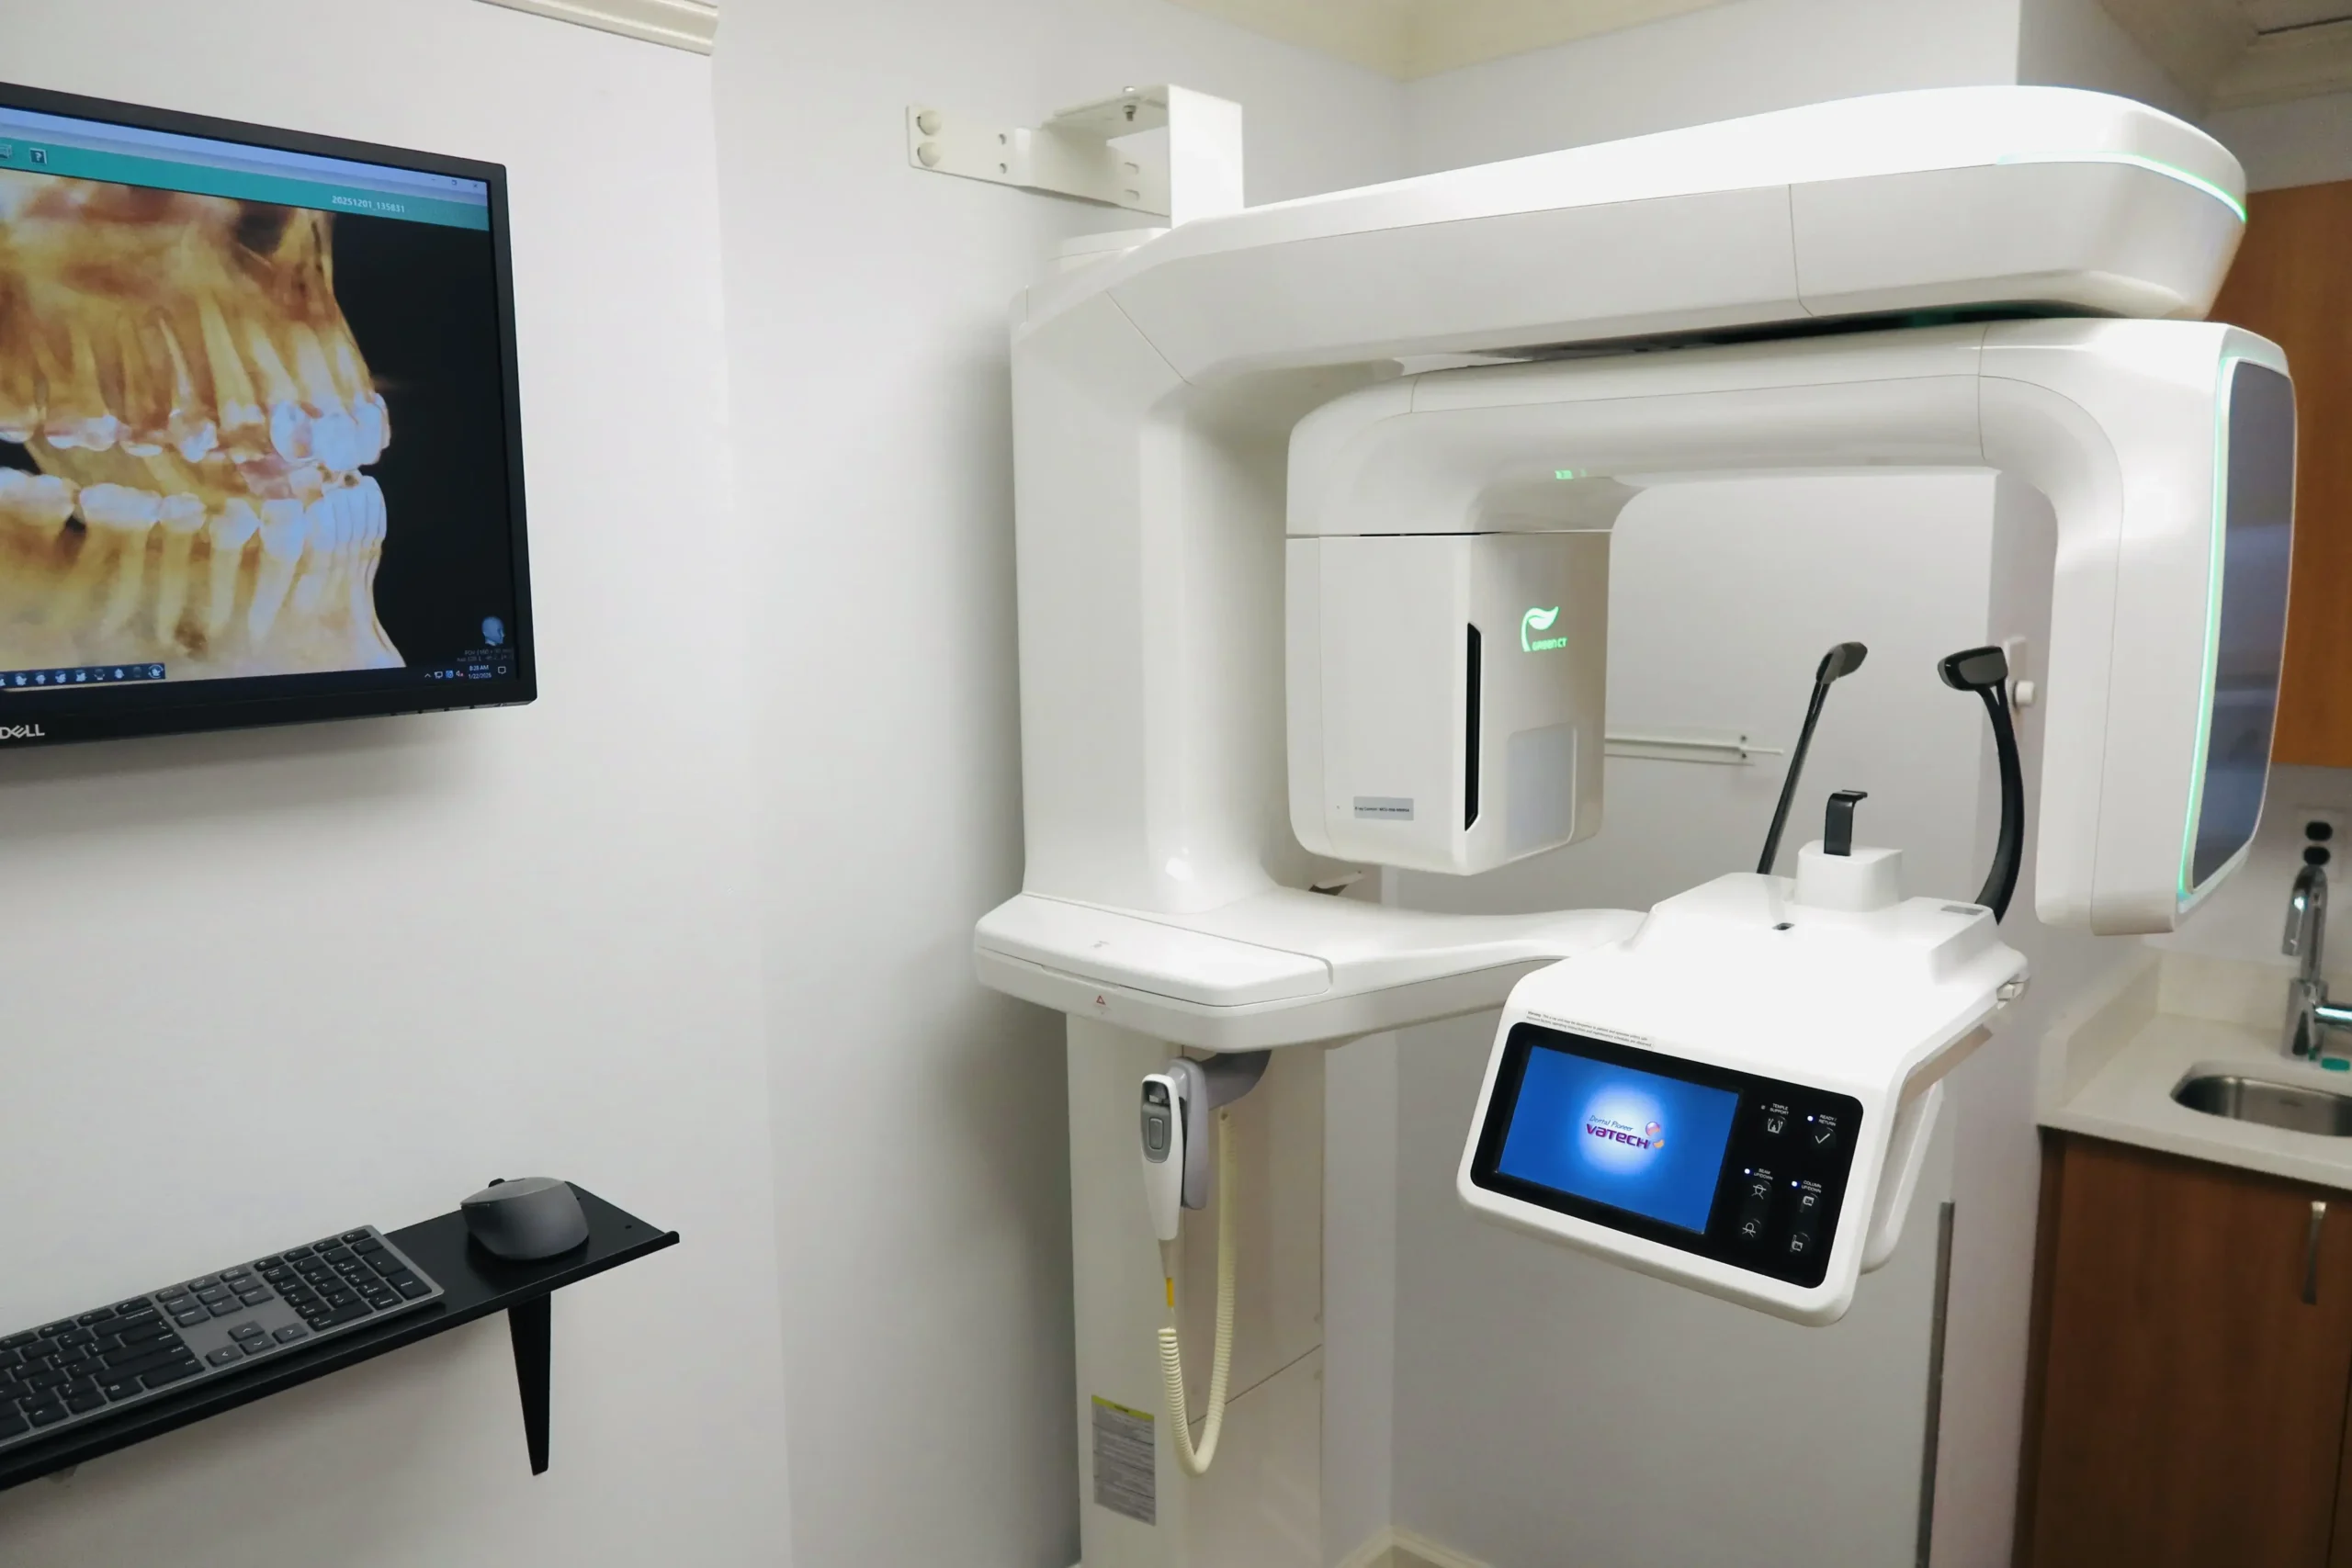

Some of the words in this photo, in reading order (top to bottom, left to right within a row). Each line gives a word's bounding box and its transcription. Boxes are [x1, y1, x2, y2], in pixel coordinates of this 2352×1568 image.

[332, 195, 405, 213] 20251201_135831
[0, 724, 45, 739] DELL
[1770, 1107, 1790, 1115] SUPPORT
[1589, 1114, 1611, 1126] Dental
[1611, 1121, 1634, 1132] Pioneer
